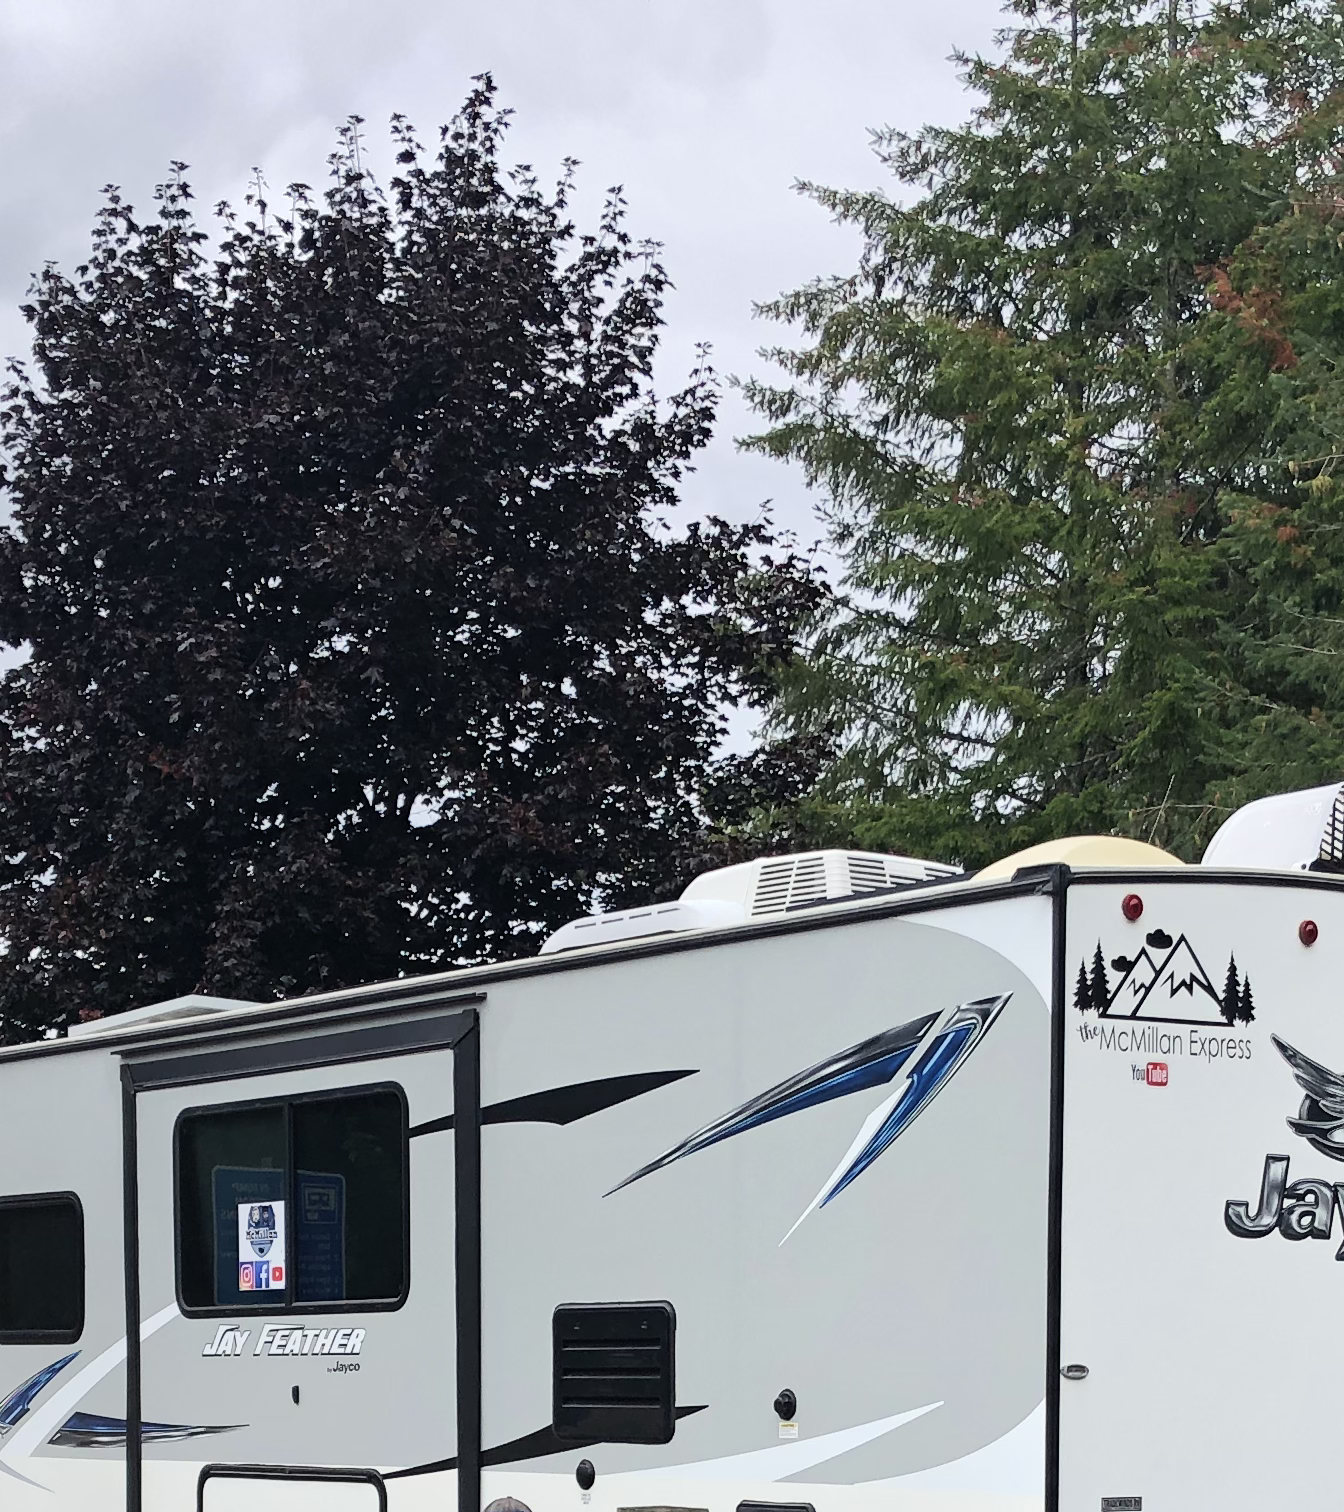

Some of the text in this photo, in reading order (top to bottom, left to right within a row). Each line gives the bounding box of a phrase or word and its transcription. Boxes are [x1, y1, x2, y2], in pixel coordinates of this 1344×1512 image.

[1076, 1023, 1252, 1063] the McMillan Express
[1131, 1063, 1168, 1086] YouTube
[202, 1323, 366, 1357] JAY FEATHER
[332, 1361, 360, 1374] Jayco
